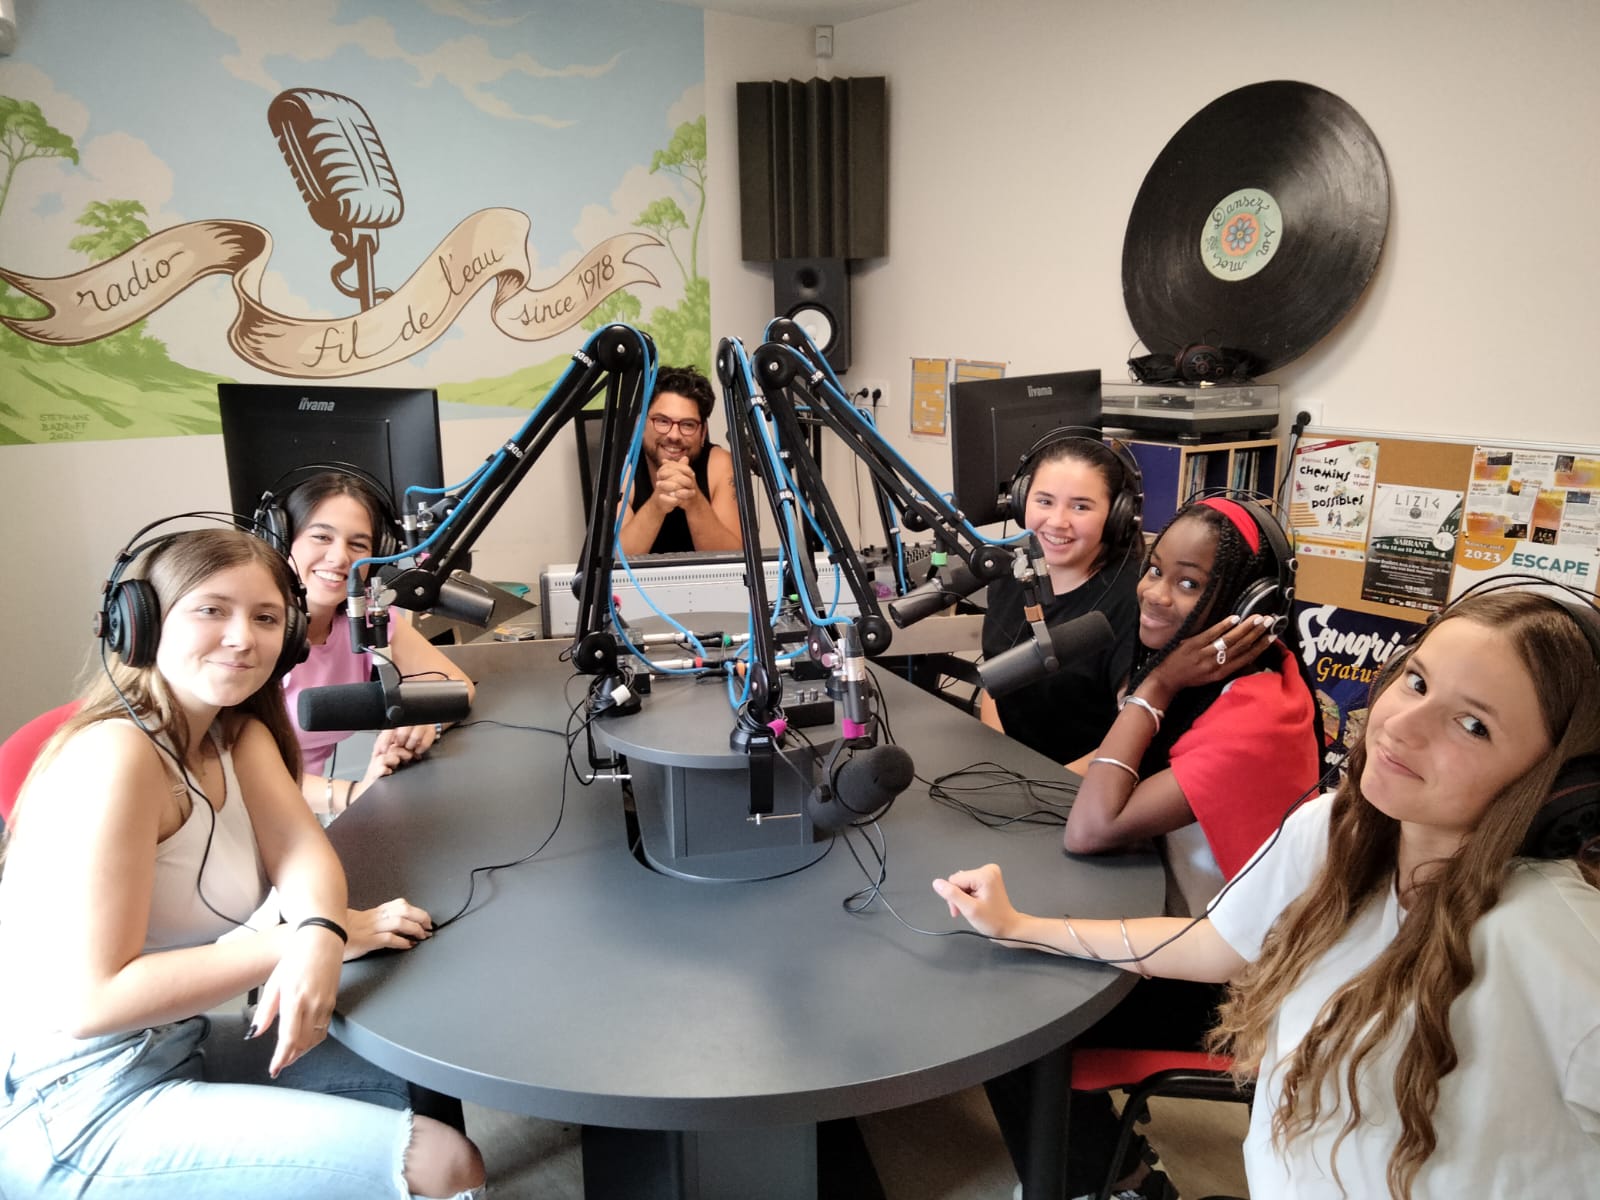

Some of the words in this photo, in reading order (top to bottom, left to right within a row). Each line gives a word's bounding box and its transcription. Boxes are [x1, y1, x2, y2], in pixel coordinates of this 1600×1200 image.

[1212, 196, 1270, 230] Dansez
[76, 251, 184, 311] radio
[512, 296, 576, 326] since
[577, 254, 615, 301] 1978
[302, 320, 372, 368] fil
[398, 304, 440, 341] de
[438, 253, 504, 296] l'eau
[298, 397, 336, 412] iiyama
[1323, 456, 1339, 466] Les
[1394, 493, 1441, 510] LIZIG
[1393, 538, 1430, 549] SARRANT
[1463, 549, 1502, 563] 2023
[1511, 552, 1590, 576] ESCAPE
